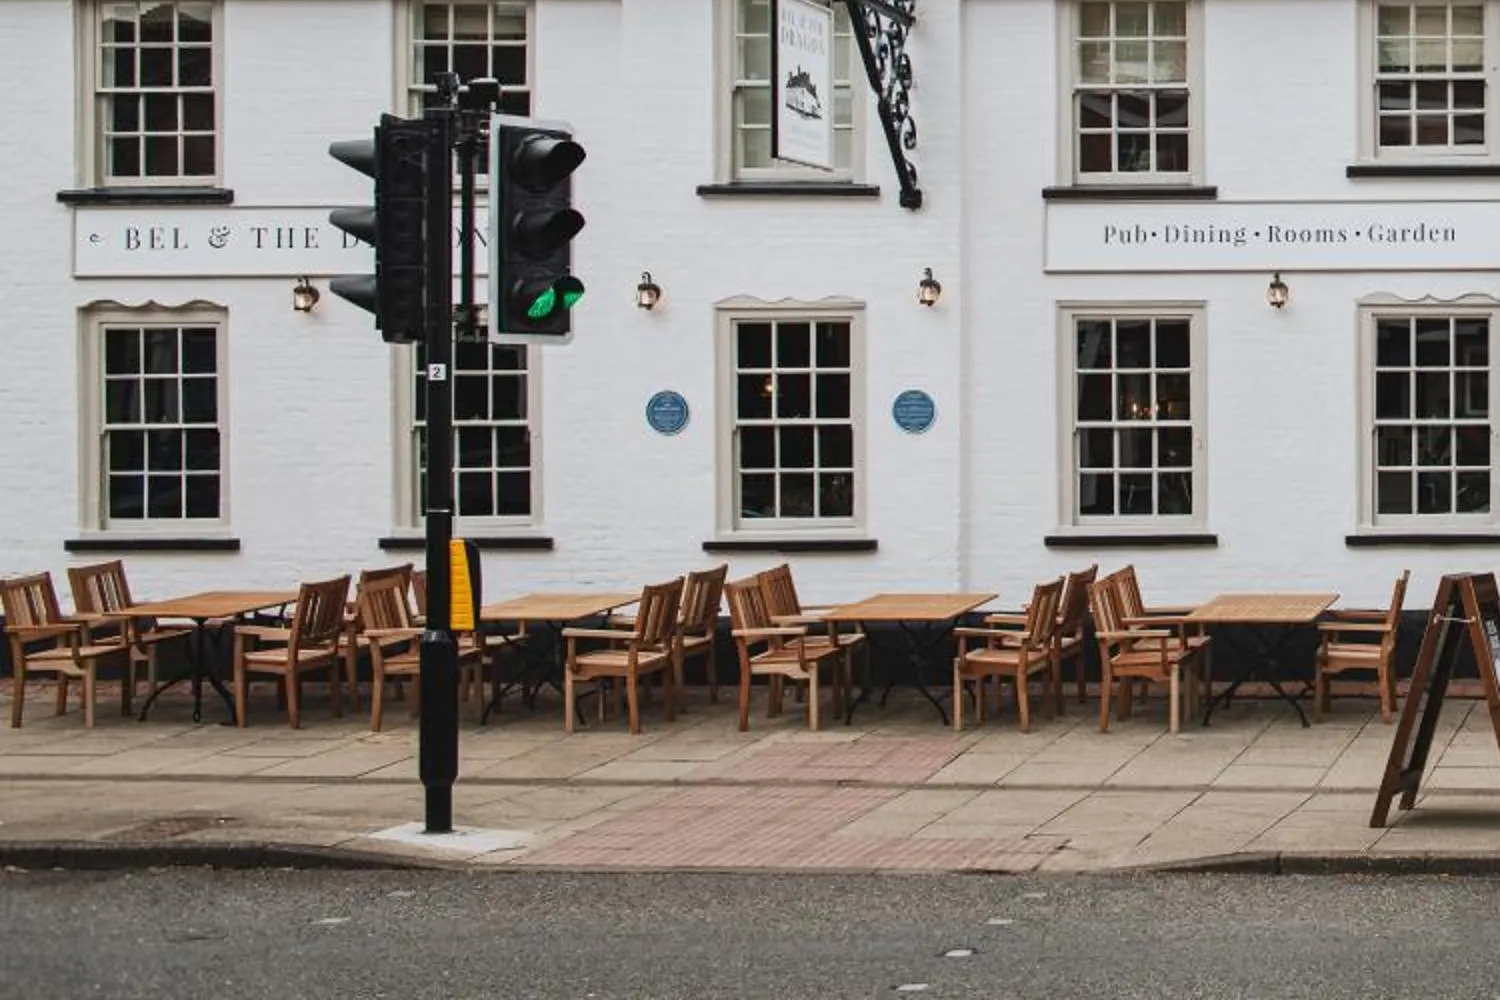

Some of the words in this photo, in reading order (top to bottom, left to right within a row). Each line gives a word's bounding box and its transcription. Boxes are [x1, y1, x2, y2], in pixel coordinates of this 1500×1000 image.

[126, 227, 189, 249] BEL
[208, 225, 231, 249] &
[250, 227, 319, 249] THE
[1104, 224, 1147, 245] Pub
[1164, 224, 1247, 247] Dining
[1268, 225, 1347, 243] Rooms
[1367, 223, 1456, 243] Garden
